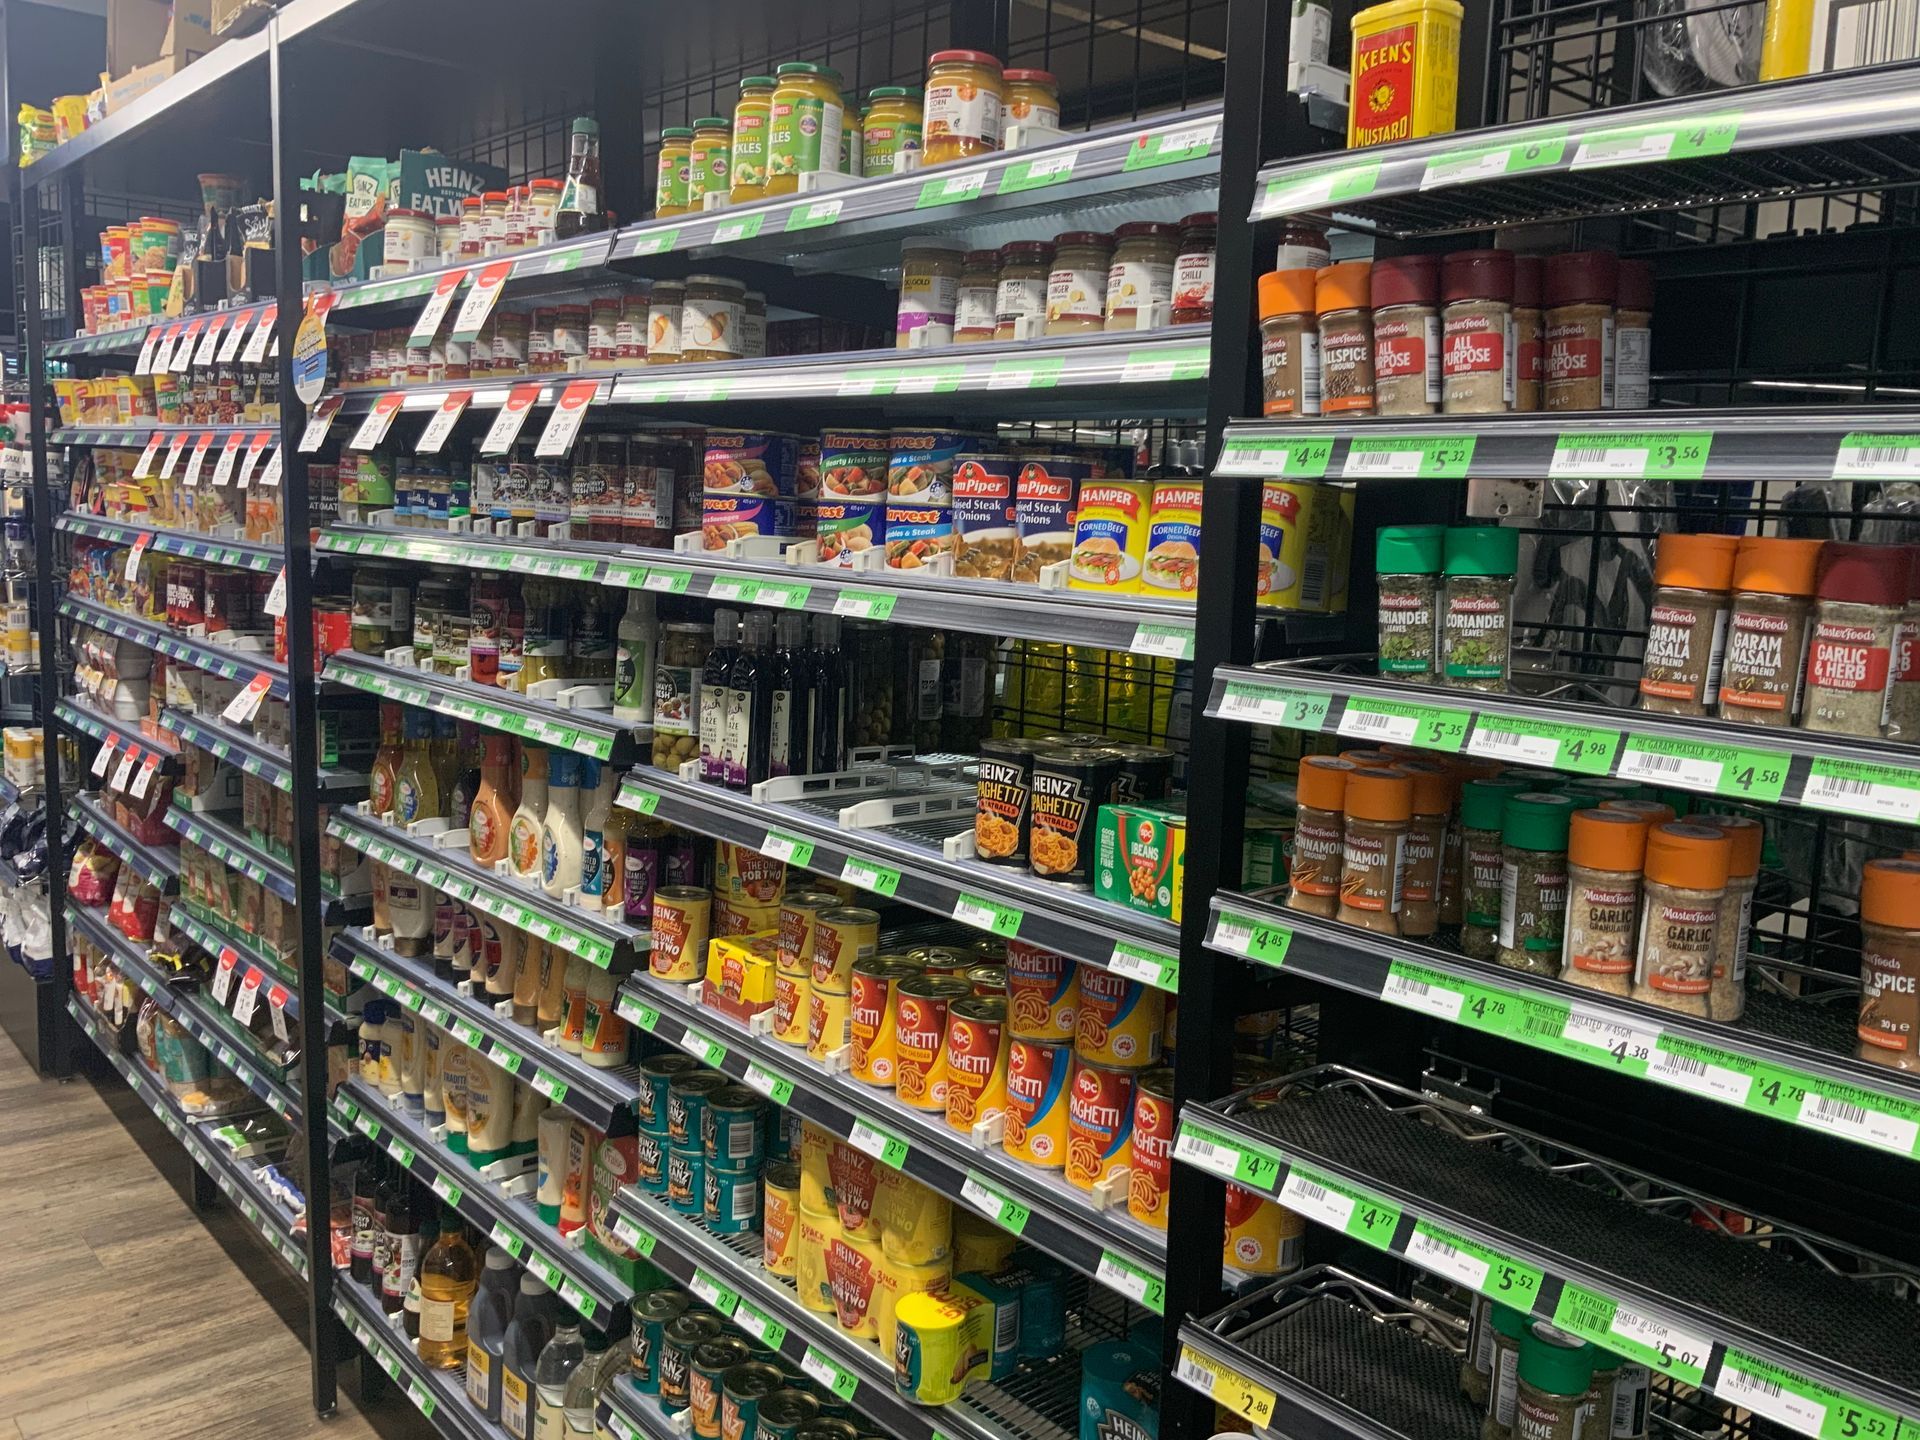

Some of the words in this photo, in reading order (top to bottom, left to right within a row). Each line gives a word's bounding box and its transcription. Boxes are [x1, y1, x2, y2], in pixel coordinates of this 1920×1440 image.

[1359, 41, 1412, 74] KEEN'S
[930, 98, 947, 107] CORN
[1356, 116, 1407, 147] MUSTARD
[424, 167, 486, 196] HEINZ
[411, 192, 444, 213] EAT
[1181, 270, 1202, 281] CHILLI
[1379, 340, 1393, 355] ALL
[1454, 335, 1472, 351] ALL
[1551, 343, 1569, 357] ALL
[1444, 347, 1491, 364] PURPOSE
[1398, 440, 1409, 448] ALL
[1410, 439, 1437, 448] PURPOSE
[909, 454, 932, 462] Steak
[1294, 447, 1325, 467] $4.64
[1430, 450, 1465, 472] $5.32
[1657, 446, 1699, 469] $3.56
[967, 480, 1003, 493] Piper
[1028, 481, 1064, 496] Piper
[974, 500, 1001, 511] Steak
[1081, 489, 1132, 505] HAMPER
[1155, 491, 1203, 506] HAMPE
[959, 510, 991, 521] Onions
[1035, 503, 1062, 513] Steak
[1020, 513, 1051, 525] Onions
[912, 527, 937, 536] Steak
[1446, 614, 1505, 628] CORIANDER
[1732, 613, 1788, 632] MasterFoods
[1462, 628, 1484, 637] LEAVES
[1649, 625, 1690, 642] GARAM
[1816, 624, 1876, 642] MasterFoods
[1646, 641, 1690, 659] MASALA
[1734, 632, 1783, 654] GARAM
[1730, 647, 1782, 669] MASALA
[1817, 643, 1867, 663] GARLIC
[1664, 657, 1683, 668] BLEND
[1731, 663, 1752, 674] SPICE
[1753, 665, 1775, 677] BLEND
[1814, 661, 1822, 676] &
[1825, 662, 1866, 681] HERB
[1672, 671, 1682, 681] 30
[1818, 676, 1833, 686] SALT
[1834, 678, 1856, 688] BLEND
[656, 683, 673, 691] WAYS
[1763, 680, 1772, 690] 30
[1294, 700, 1324, 721] $3.96
[1428, 722, 1462, 743] $5.35
[1563, 739, 1606, 762] $4.98
[1647, 742, 1672, 755] GARAM
[1674, 745, 1704, 758] MASALA
[979, 763, 1016, 784] HEINZ
[1731, 765, 1779, 792] $4.58
[977, 781, 1024, 806] PAGHETTI
[1034, 776, 1071, 798] HEINZ
[1032, 794, 1082, 820] PAGHETTI
[1135, 843, 1159, 861] BEANS
[1295, 838, 1343, 854] CINNAMON
[1303, 851, 1327, 862] GROUND
[747, 862, 763, 870] THE
[764, 861, 778, 870] ONE
[742, 871, 762, 881] FOR
[763, 870, 781, 881] TWO
[1584, 890, 1636, 904] MasterFoods
[1589, 906, 1633, 923] GARLIC
[1662, 906, 1717, 923] MasterFoods
[1589, 924, 1631, 933] GRANULATED
[1667, 926, 1712, 942] GARLIC
[661, 934, 675, 944] ONE
[1255, 928, 1282, 950] $4.85
[1667, 941, 1710, 952] GRANULATED
[1006, 949, 1062, 973] SPAGHETTI
[1875, 972, 1915, 993] SPICE
[1469, 994, 1506, 1019] $4.78
[902, 1010, 917, 1022] spc
[1533, 1003, 1557, 1018] GARLIC
[1557, 1010, 1602, 1030] GRANULATED
[897, 1027, 938, 1049] PAGHETTI
[954, 1032, 969, 1044] spc
[1607, 1038, 1649, 1064] $4.38
[1080, 1079, 1098, 1094] spc
[1758, 1077, 1805, 1106] $4.78
[1829, 1082, 1855, 1098] MIXED
[1858, 1089, 1881, 1107] SPICE
[1884, 1098, 1906, 1112] TRAD
[1070, 1092, 1119, 1127] PAGHETTI
[1138, 1107, 1155, 1123] spc
[838, 1148, 866, 1169] HEINZ
[1140, 1155, 1162, 1169] TOMATO
[1245, 1154, 1274, 1177] $4.77
[848, 1182, 863, 1197] ONE
[847, 1194, 869, 1210] TWO
[1361, 1205, 1392, 1229] $4.77
[836, 1243, 864, 1268] HEINZ
[1498, 1265, 1534, 1290] $5.52
[845, 1280, 861, 1296] ONE
[844, 1292, 867, 1308] TWO
[1579, 1293, 1608, 1314] PAPRIKA
[1609, 1303, 1638, 1327] SMOKED
[1656, 1341, 1698, 1369] $5.07
[1241, 1392, 1268, 1416] $2.88
[1519, 1414, 1552, 1439] THYME
[1838, 1406, 1886, 1437] $5.52
